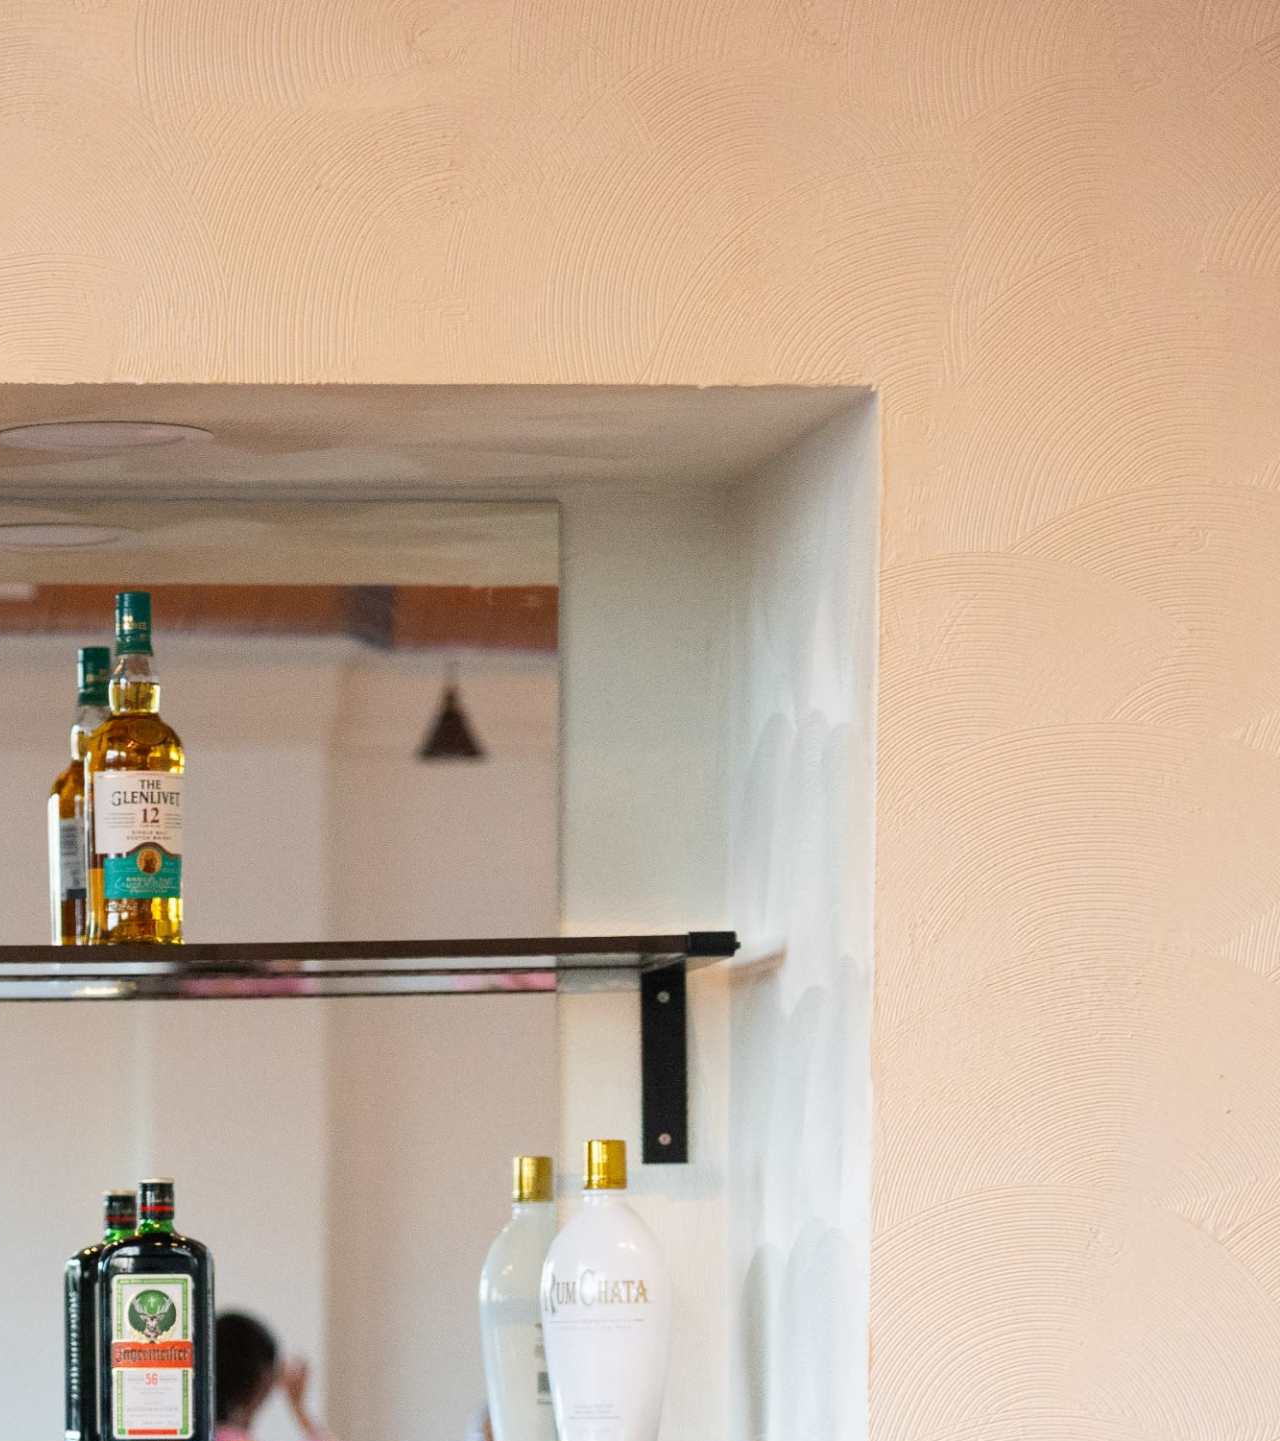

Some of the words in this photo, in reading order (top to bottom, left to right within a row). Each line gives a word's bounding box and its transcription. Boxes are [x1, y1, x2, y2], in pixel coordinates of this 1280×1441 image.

[144, 780, 161, 789] THE
[111, 791, 180, 806] GLENLIVET
[142, 808, 159, 823] 12
